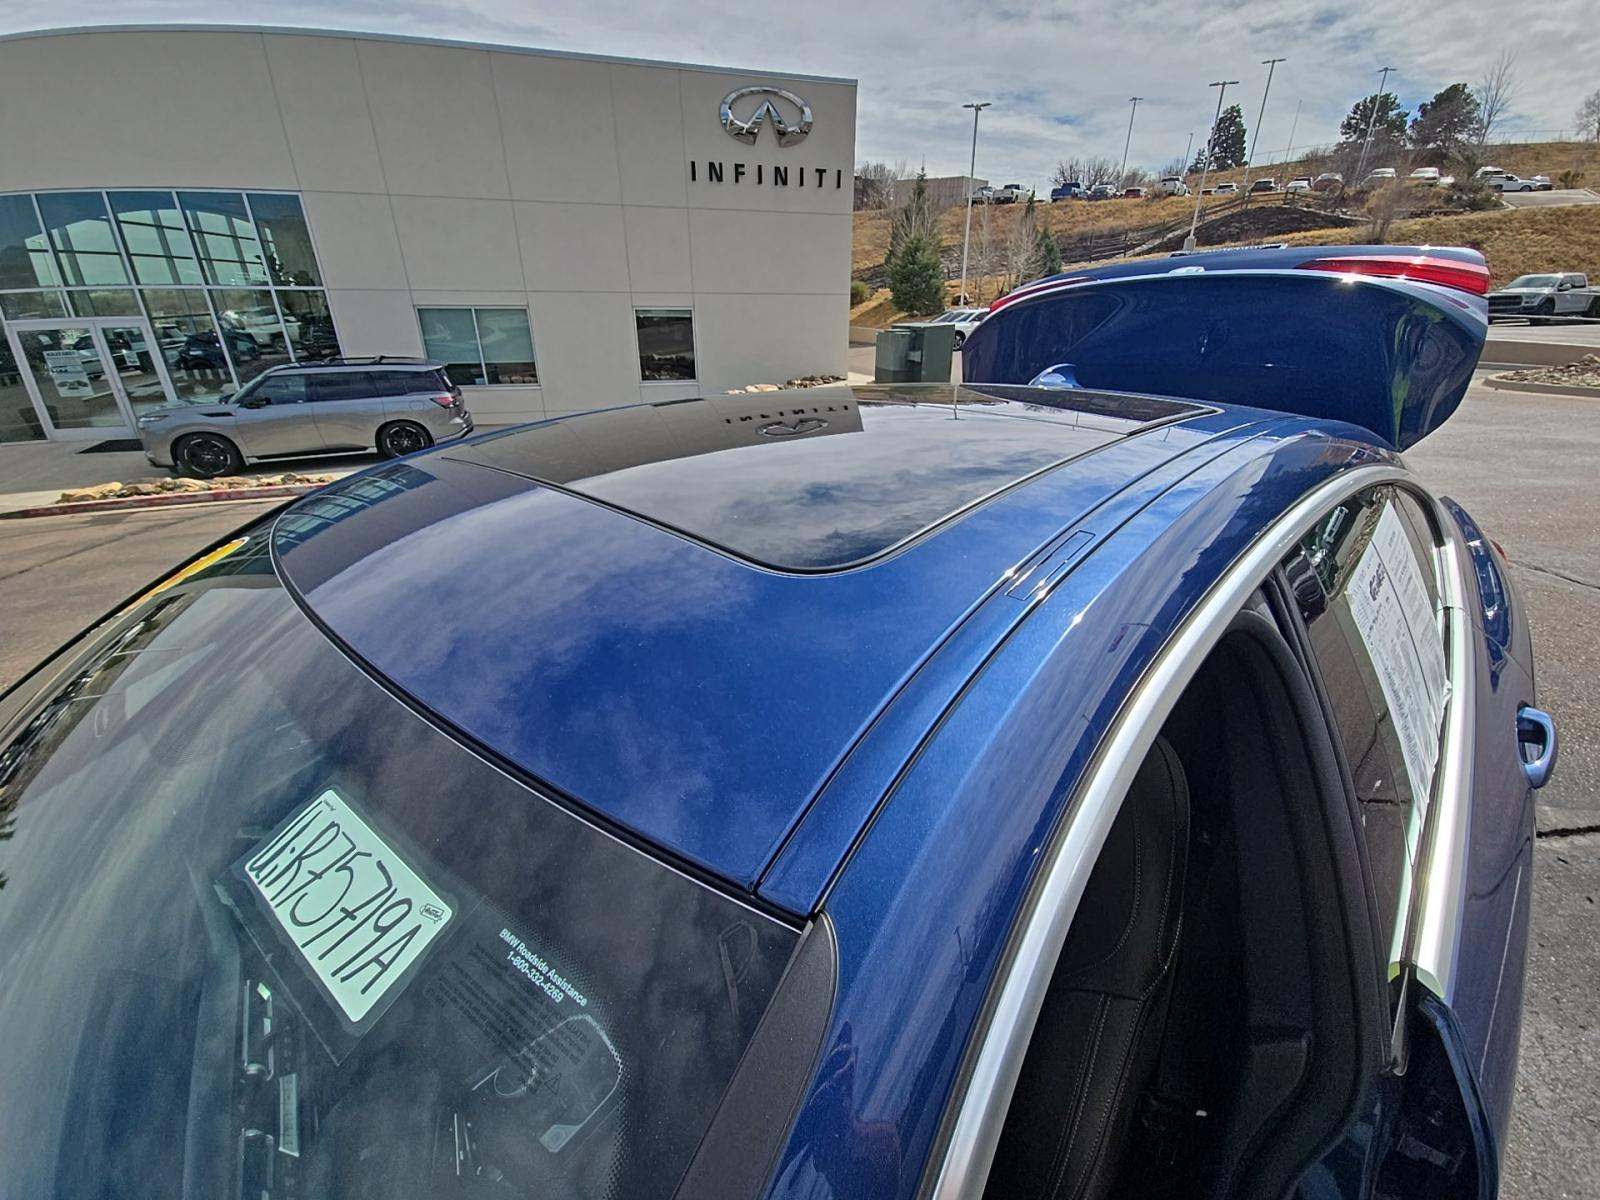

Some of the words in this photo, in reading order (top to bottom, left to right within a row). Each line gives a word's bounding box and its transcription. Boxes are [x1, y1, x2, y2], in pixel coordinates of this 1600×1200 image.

[690, 161, 841, 189] INFINITI
[499, 928, 521, 948] BMW
[516, 942, 549, 974] Roadside
[547, 969, 588, 1007] Assistance
[507, 951, 564, 1003] 1-800-332-4269
